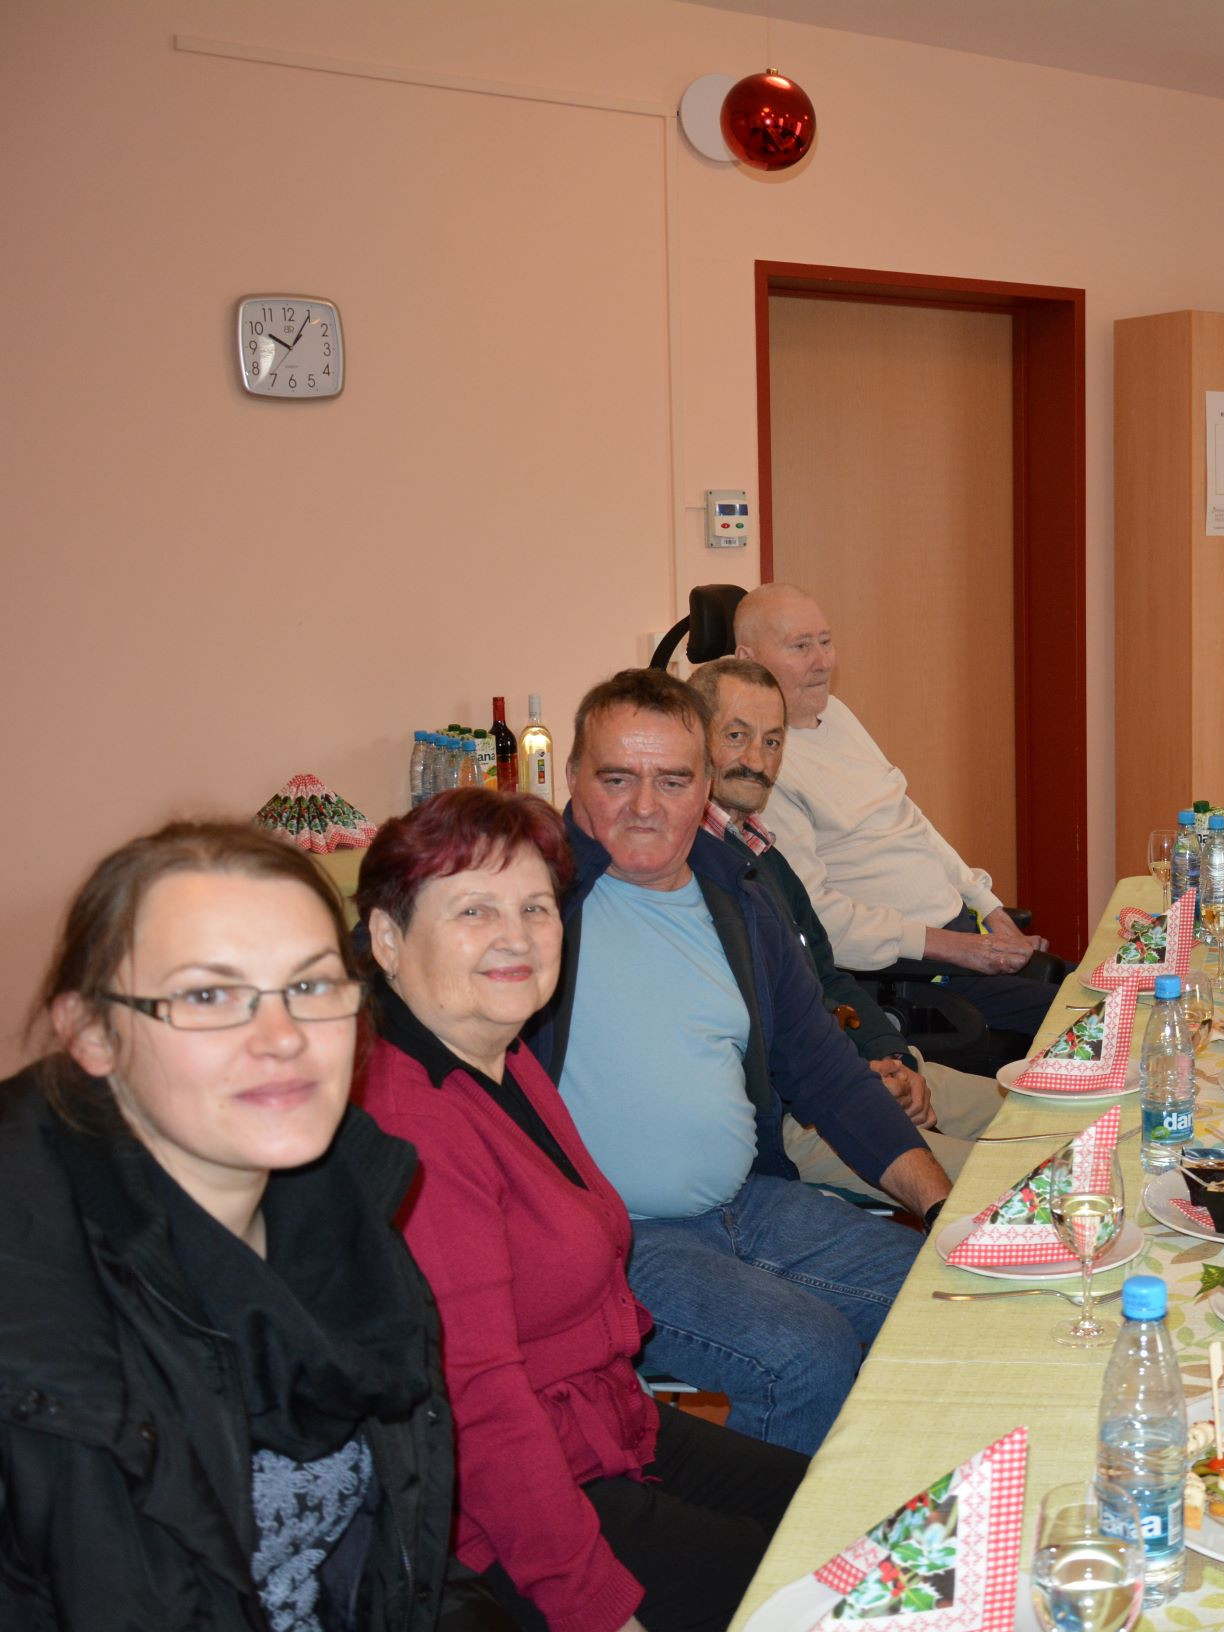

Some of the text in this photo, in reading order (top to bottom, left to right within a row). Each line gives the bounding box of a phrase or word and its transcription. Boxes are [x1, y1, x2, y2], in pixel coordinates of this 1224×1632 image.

[262, 307, 273, 321] 11
[282, 307, 295, 322] 12
[249, 321, 263, 335] 10
[321, 323, 329, 337] 2
[249, 340, 257, 355] 9
[323, 342, 331, 357] 3
[251, 361, 260, 376] 8
[322, 364, 330, 376] 4
[269, 373, 278, 387] 7
[288, 374, 297, 388] 6
[307, 374, 316, 388] 5
